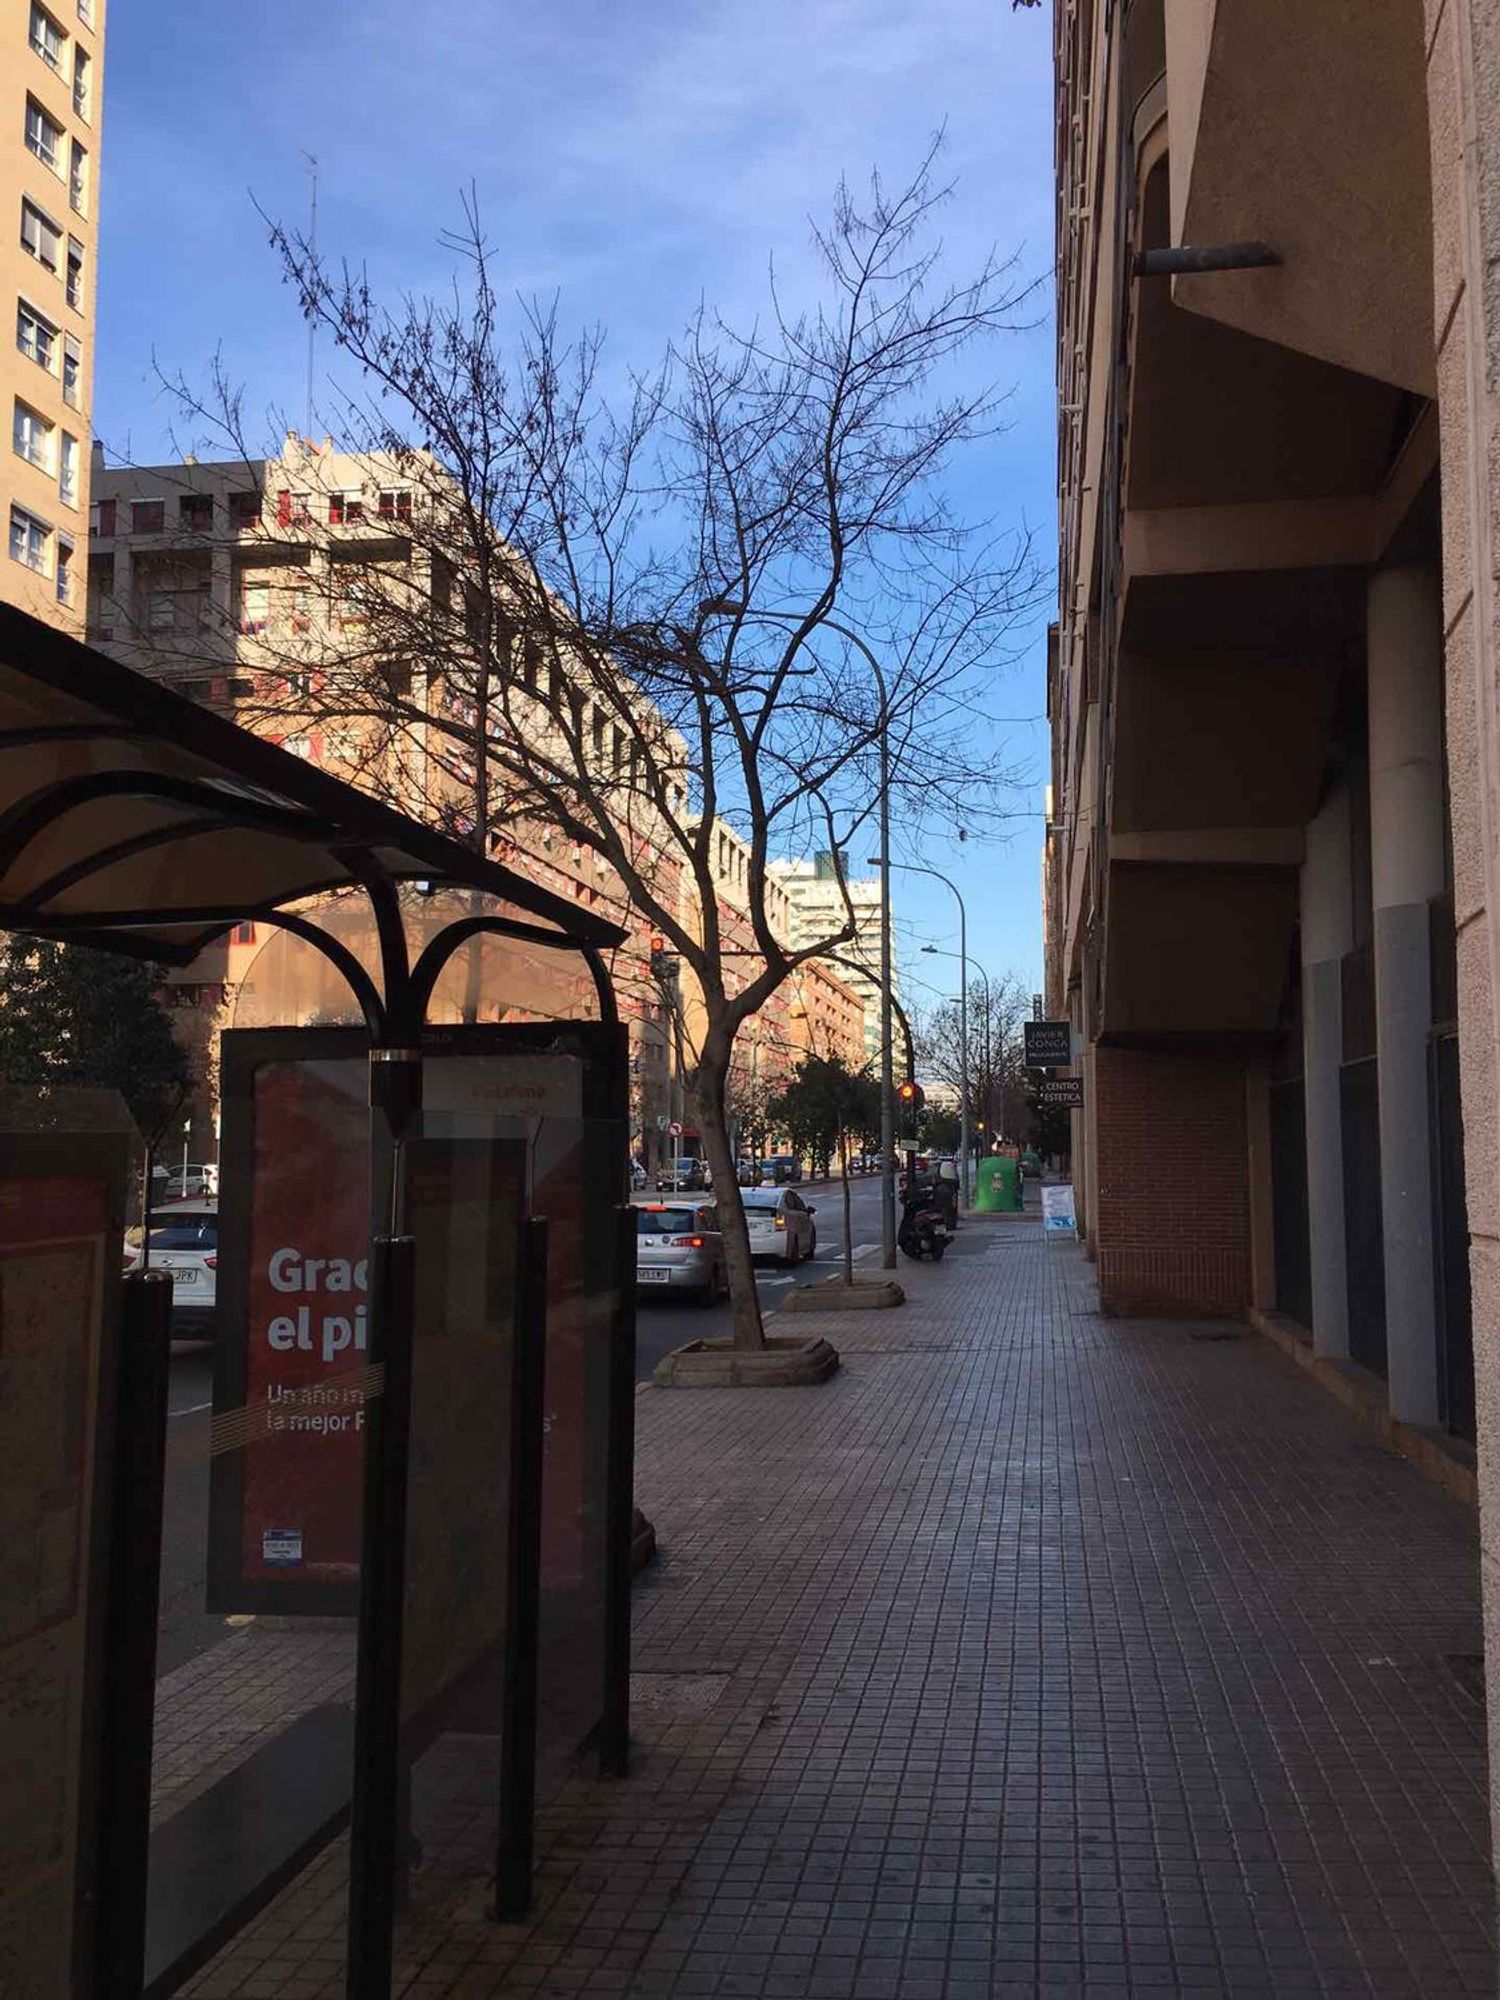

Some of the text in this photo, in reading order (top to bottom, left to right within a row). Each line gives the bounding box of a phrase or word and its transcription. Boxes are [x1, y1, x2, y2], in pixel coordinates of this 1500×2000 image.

[1031, 1031, 1064, 1040] JAVIER
[1027, 1041, 1068, 1049] CONCA
[1046, 1082, 1079, 1092] CENTRO
[267, 1305, 367, 1361] el pi
[266, 1410, 285, 1430] la
[290, 1412, 351, 1436] mejor
